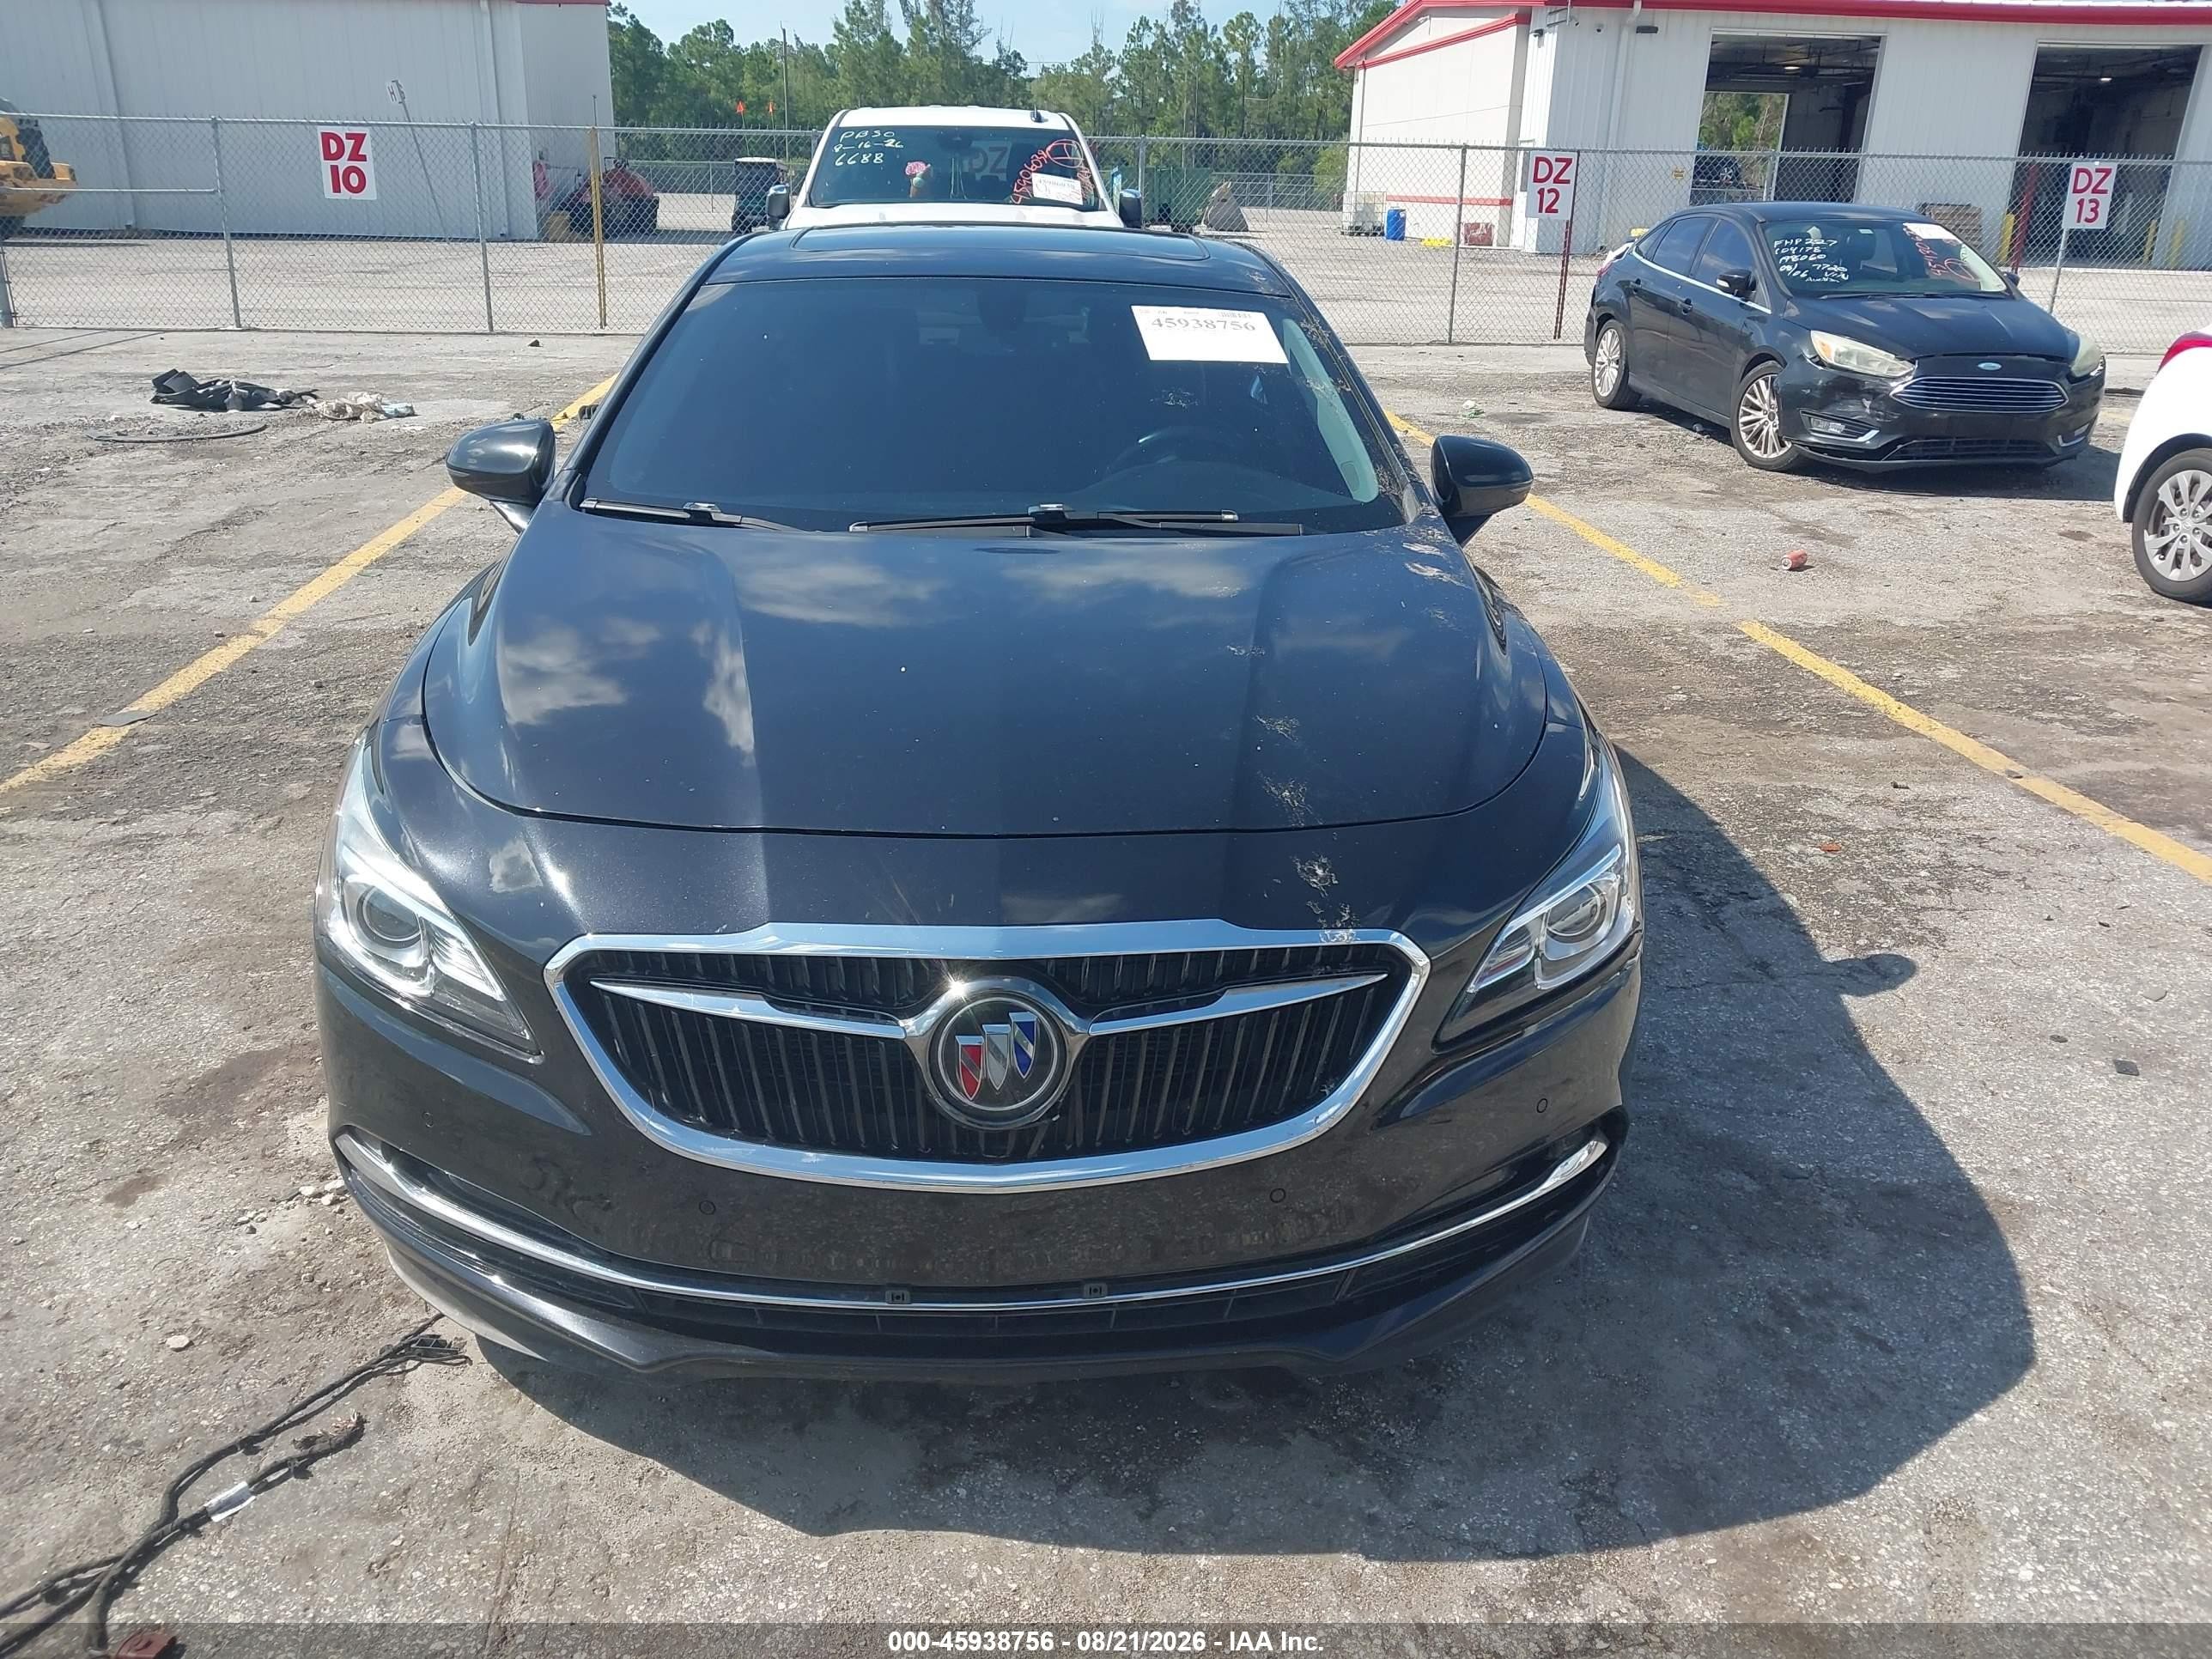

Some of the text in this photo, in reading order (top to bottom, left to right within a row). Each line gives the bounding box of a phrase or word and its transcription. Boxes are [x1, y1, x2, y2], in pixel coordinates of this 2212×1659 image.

[320, 131, 368, 162] DZ
[840, 130, 895, 143] PBSO
[835, 152, 884, 167] 6688
[1533, 156, 1573, 185] DZ
[2072, 167, 2112, 195] DZ
[1537, 187, 1560, 214] 12
[2076, 198, 2100, 223] 13
[1152, 318, 1256, 331] 45938756
